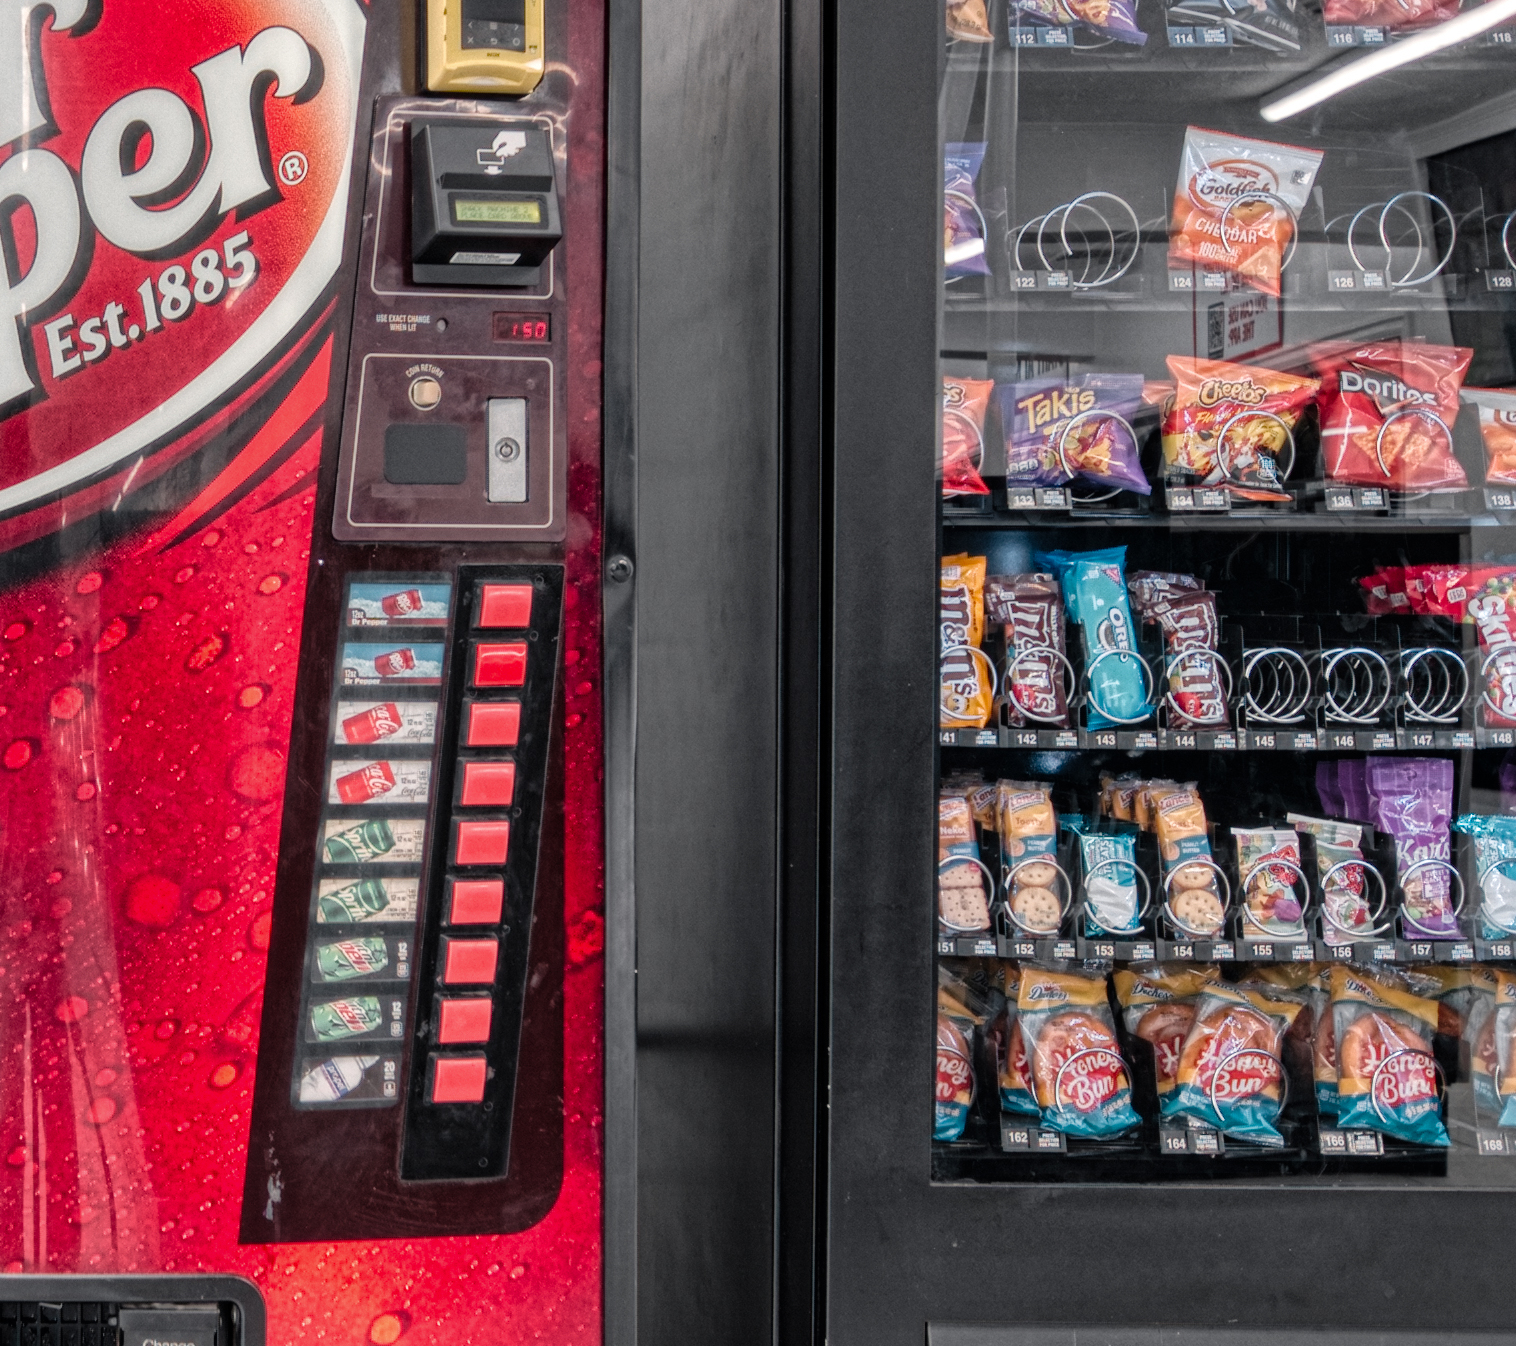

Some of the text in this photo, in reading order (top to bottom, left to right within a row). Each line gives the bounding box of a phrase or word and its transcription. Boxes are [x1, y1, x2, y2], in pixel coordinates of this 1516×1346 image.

[1015, 33, 1512, 44] 112 114 116 118
[1015, 276, 1512, 288] 122 124 126 128
[376, 314, 430, 323] USE EXACT CHANGE
[406, 364, 444, 378] COIN RETURN
[1199, 379, 1266, 408] Cheetos
[1341, 371, 1438, 405] Doritos
[1018, 387, 1095, 433] Takis
[1014, 495, 1512, 507] 132 134 136 138
[1017, 733, 1036, 745] 142
[1096, 735, 1116, 746] 143
[1175, 736, 1195, 747] 144
[1254, 735, 1275, 747] 145
[1334, 735, 1354, 747] 146
[1413, 735, 1432, 746] 147
[1492, 733, 1512, 744] 148
[398, 942, 408, 953] 12
[1014, 943, 1034, 954] 152
[1094, 945, 1114, 956] 153
[1173, 945, 1193, 957] 154
[1252, 945, 1272, 956] 155
[1332, 947, 1352, 958] 156
[1411, 944, 1431, 955] 157
[1490, 945, 1511, 956] 158
[392, 1002, 402, 1012] 12
[384, 1061, 395, 1072] 20
[1213, 1070, 1264, 1096] Bun
[1381, 1073, 1430, 1104] Bun
[1069, 1076, 1115, 1110] Bun
[1009, 1132, 1503, 1151] 162 164 166 168
